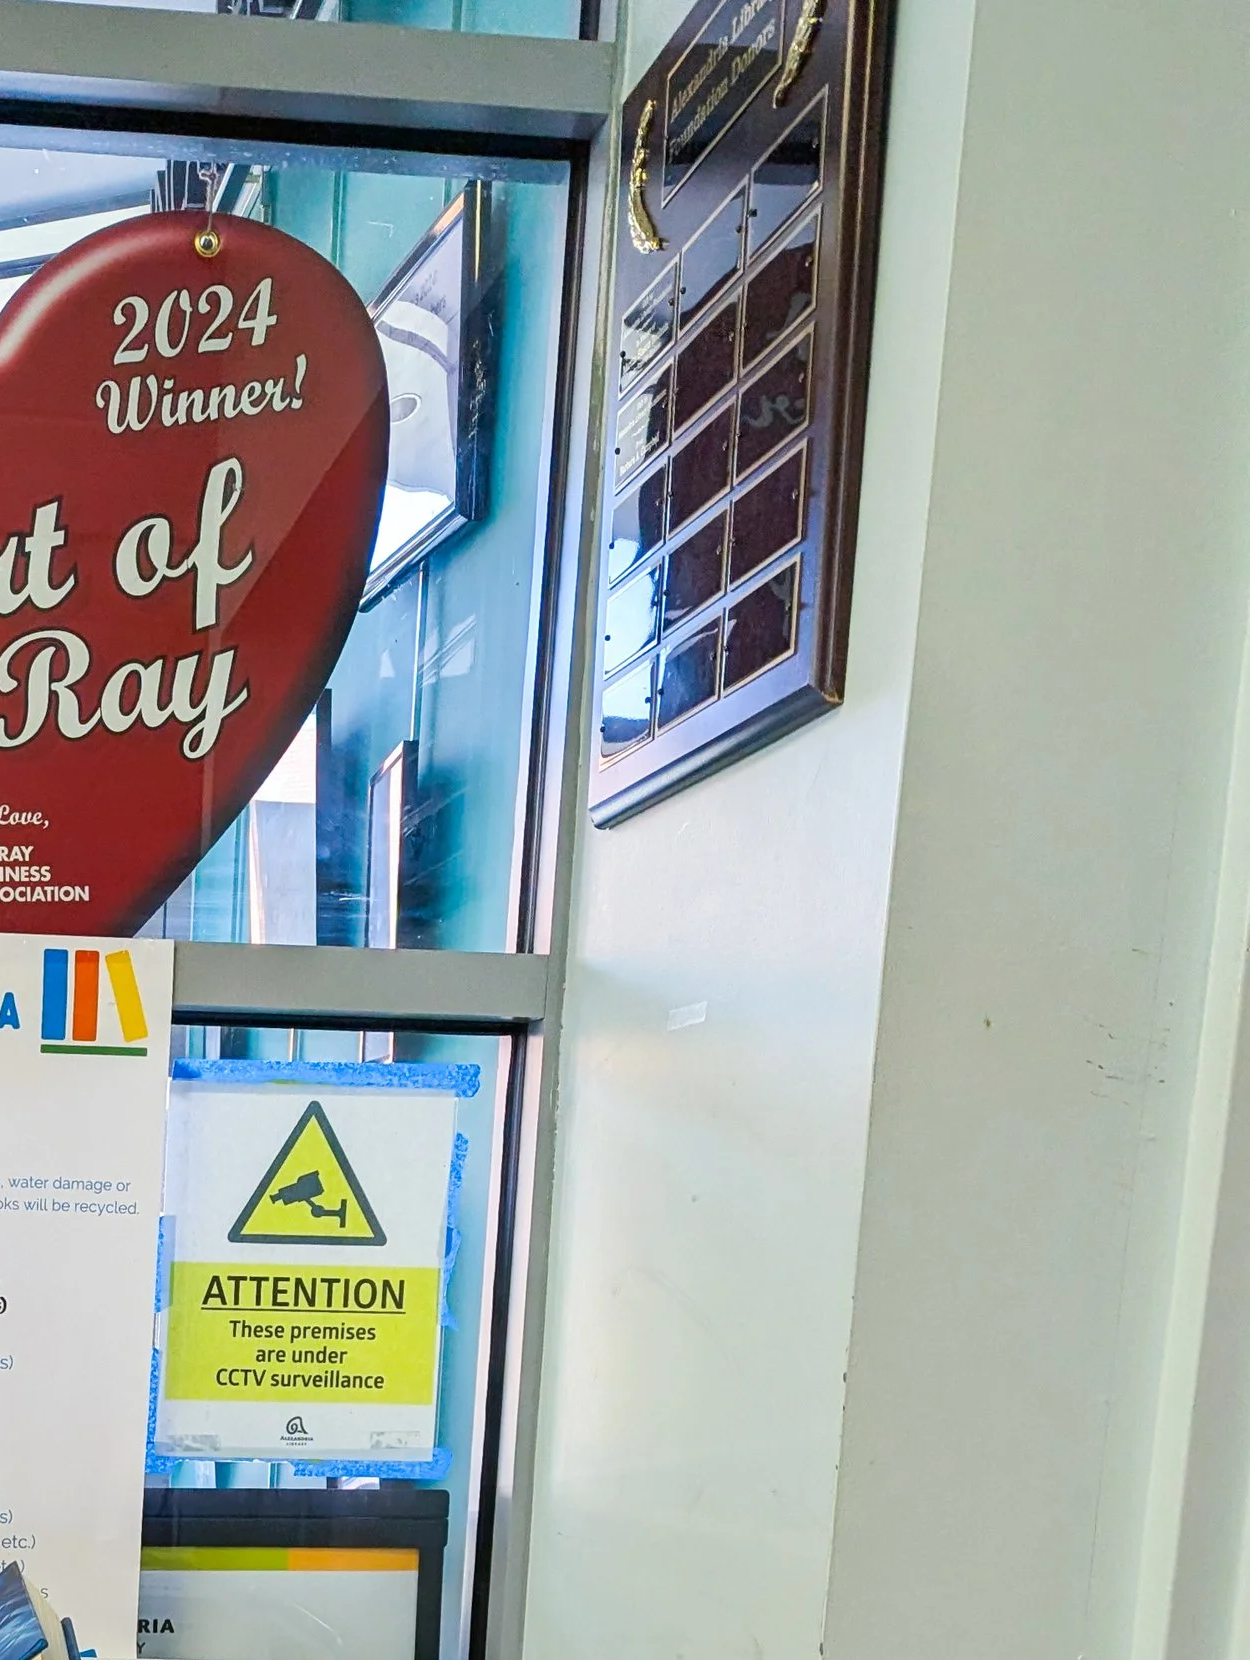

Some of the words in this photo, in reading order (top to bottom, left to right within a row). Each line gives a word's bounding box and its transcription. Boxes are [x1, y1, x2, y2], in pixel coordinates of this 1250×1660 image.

[111, 277, 280, 367] 2024
[95, 356, 309, 436] Winner!
[113, 456, 254, 633] of
[7, 1175, 50, 1190] water
[52, 1175, 113, 1196] damage
[115, 1180, 132, 1193] or
[23, 1197, 49, 1213] will
[51, 1197, 71, 1213] be
[74, 1199, 140, 1217] recycled.
[201, 1275, 407, 1311] ATTENTION
[229, 1319, 286, 1341] These
[290, 1322, 377, 1346] premises
[255, 1348, 287, 1364] are
[291, 1345, 348, 1365] under
[215, 1368, 266, 1389] CCTV
[269, 1369, 386, 1391] surveillance
[1, 1533, 36, 1551] etc.)
